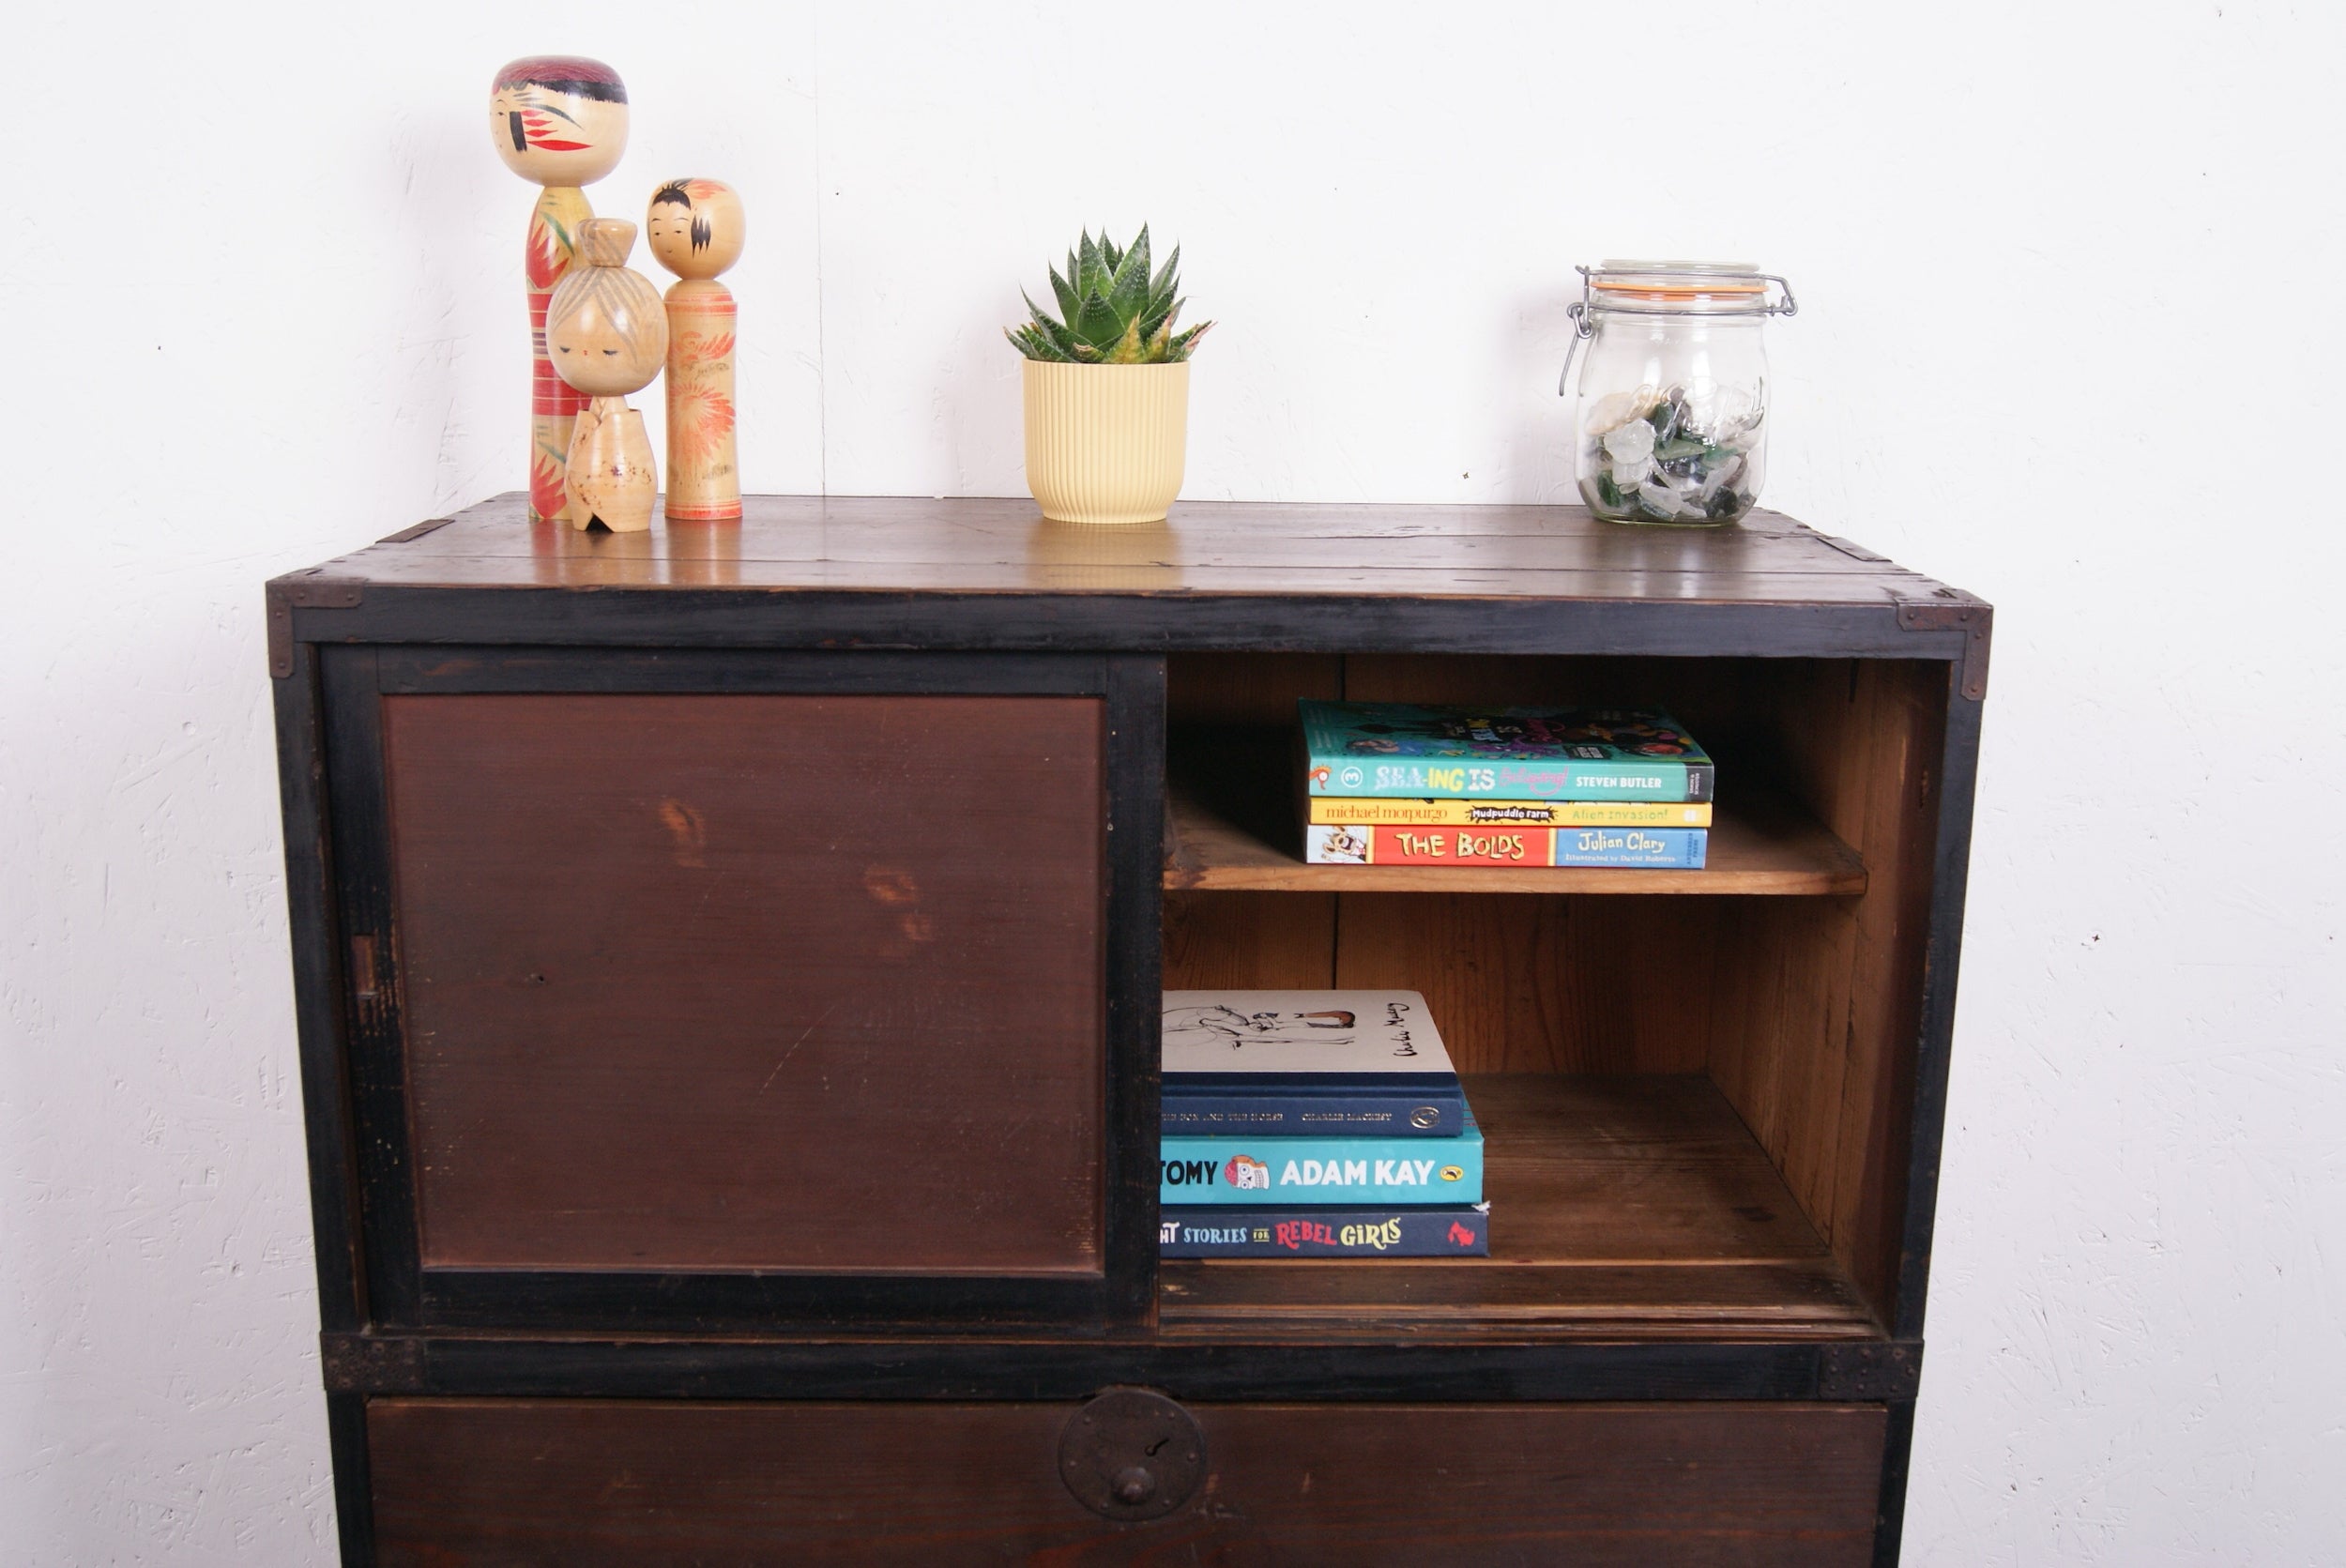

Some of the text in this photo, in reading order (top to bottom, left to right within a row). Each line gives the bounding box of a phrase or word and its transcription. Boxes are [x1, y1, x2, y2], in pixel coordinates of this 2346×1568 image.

[1468, 768, 1496, 791] IS
[1577, 776, 1663, 788] STEVEN BUTLER
[1326, 805, 1448, 822] michael morpurgo
[1472, 808, 1549, 819] Mudpuddle Farm
[1573, 809, 1668, 820] Alien Invasion!
[1395, 831, 1525, 860] THE BOLDS
[1578, 830, 1666, 854] Julian Clary
[1280, 1159, 1436, 1186] ADAM KAY
[1183, 1226, 1248, 1244] STORIES
[1253, 1230, 1270, 1240] FOR
[1274, 1220, 1337, 1250] REBEL
